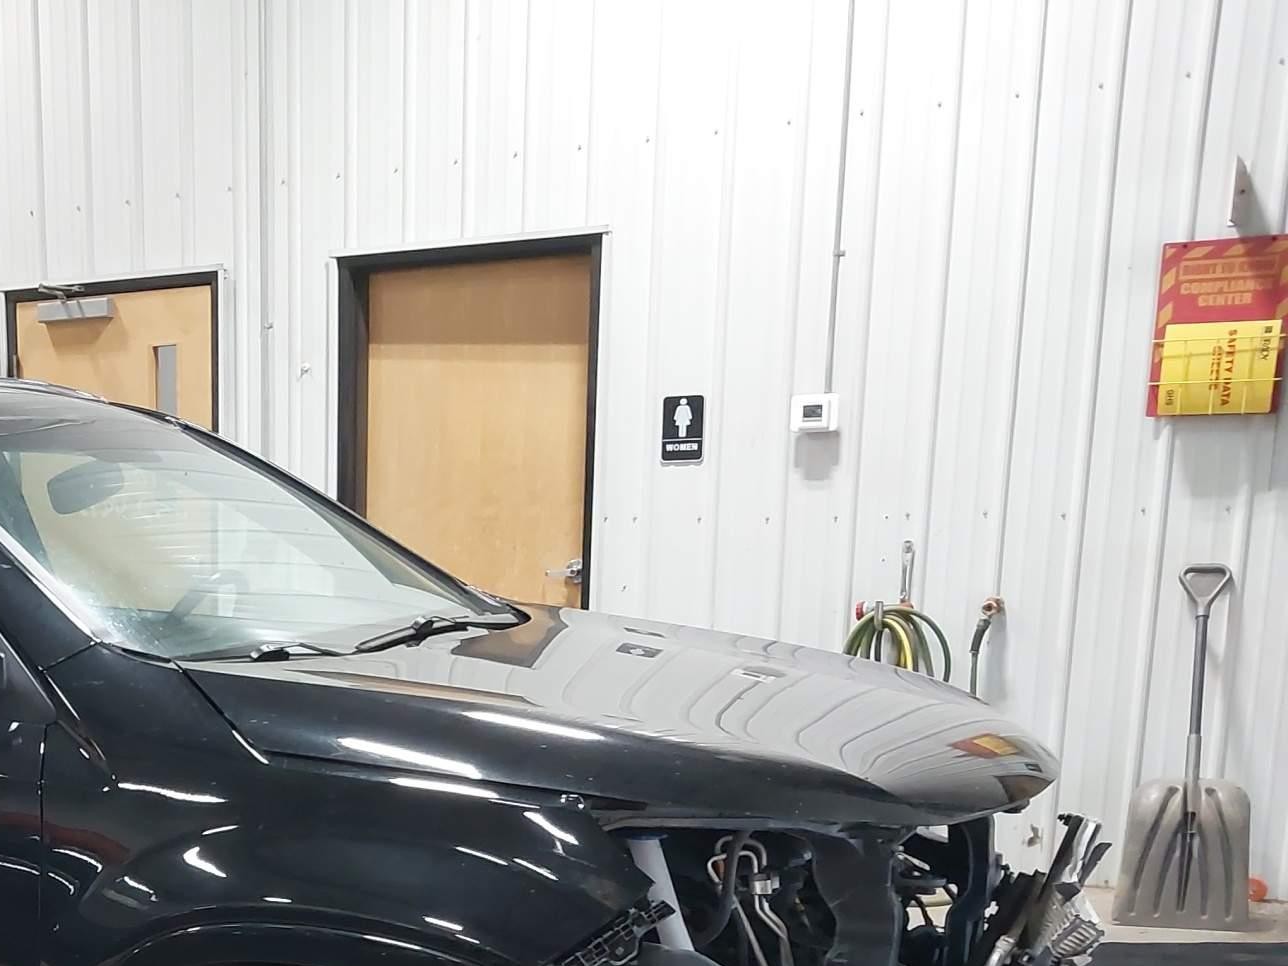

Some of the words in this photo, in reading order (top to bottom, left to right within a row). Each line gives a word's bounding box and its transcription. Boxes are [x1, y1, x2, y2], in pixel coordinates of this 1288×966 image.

[1197, 293, 1253, 307] CENTER
[1223, 329, 1238, 373] SAFETY
[1220, 377, 1232, 406] DATA
[665, 442, 698, 452] WOMEN
